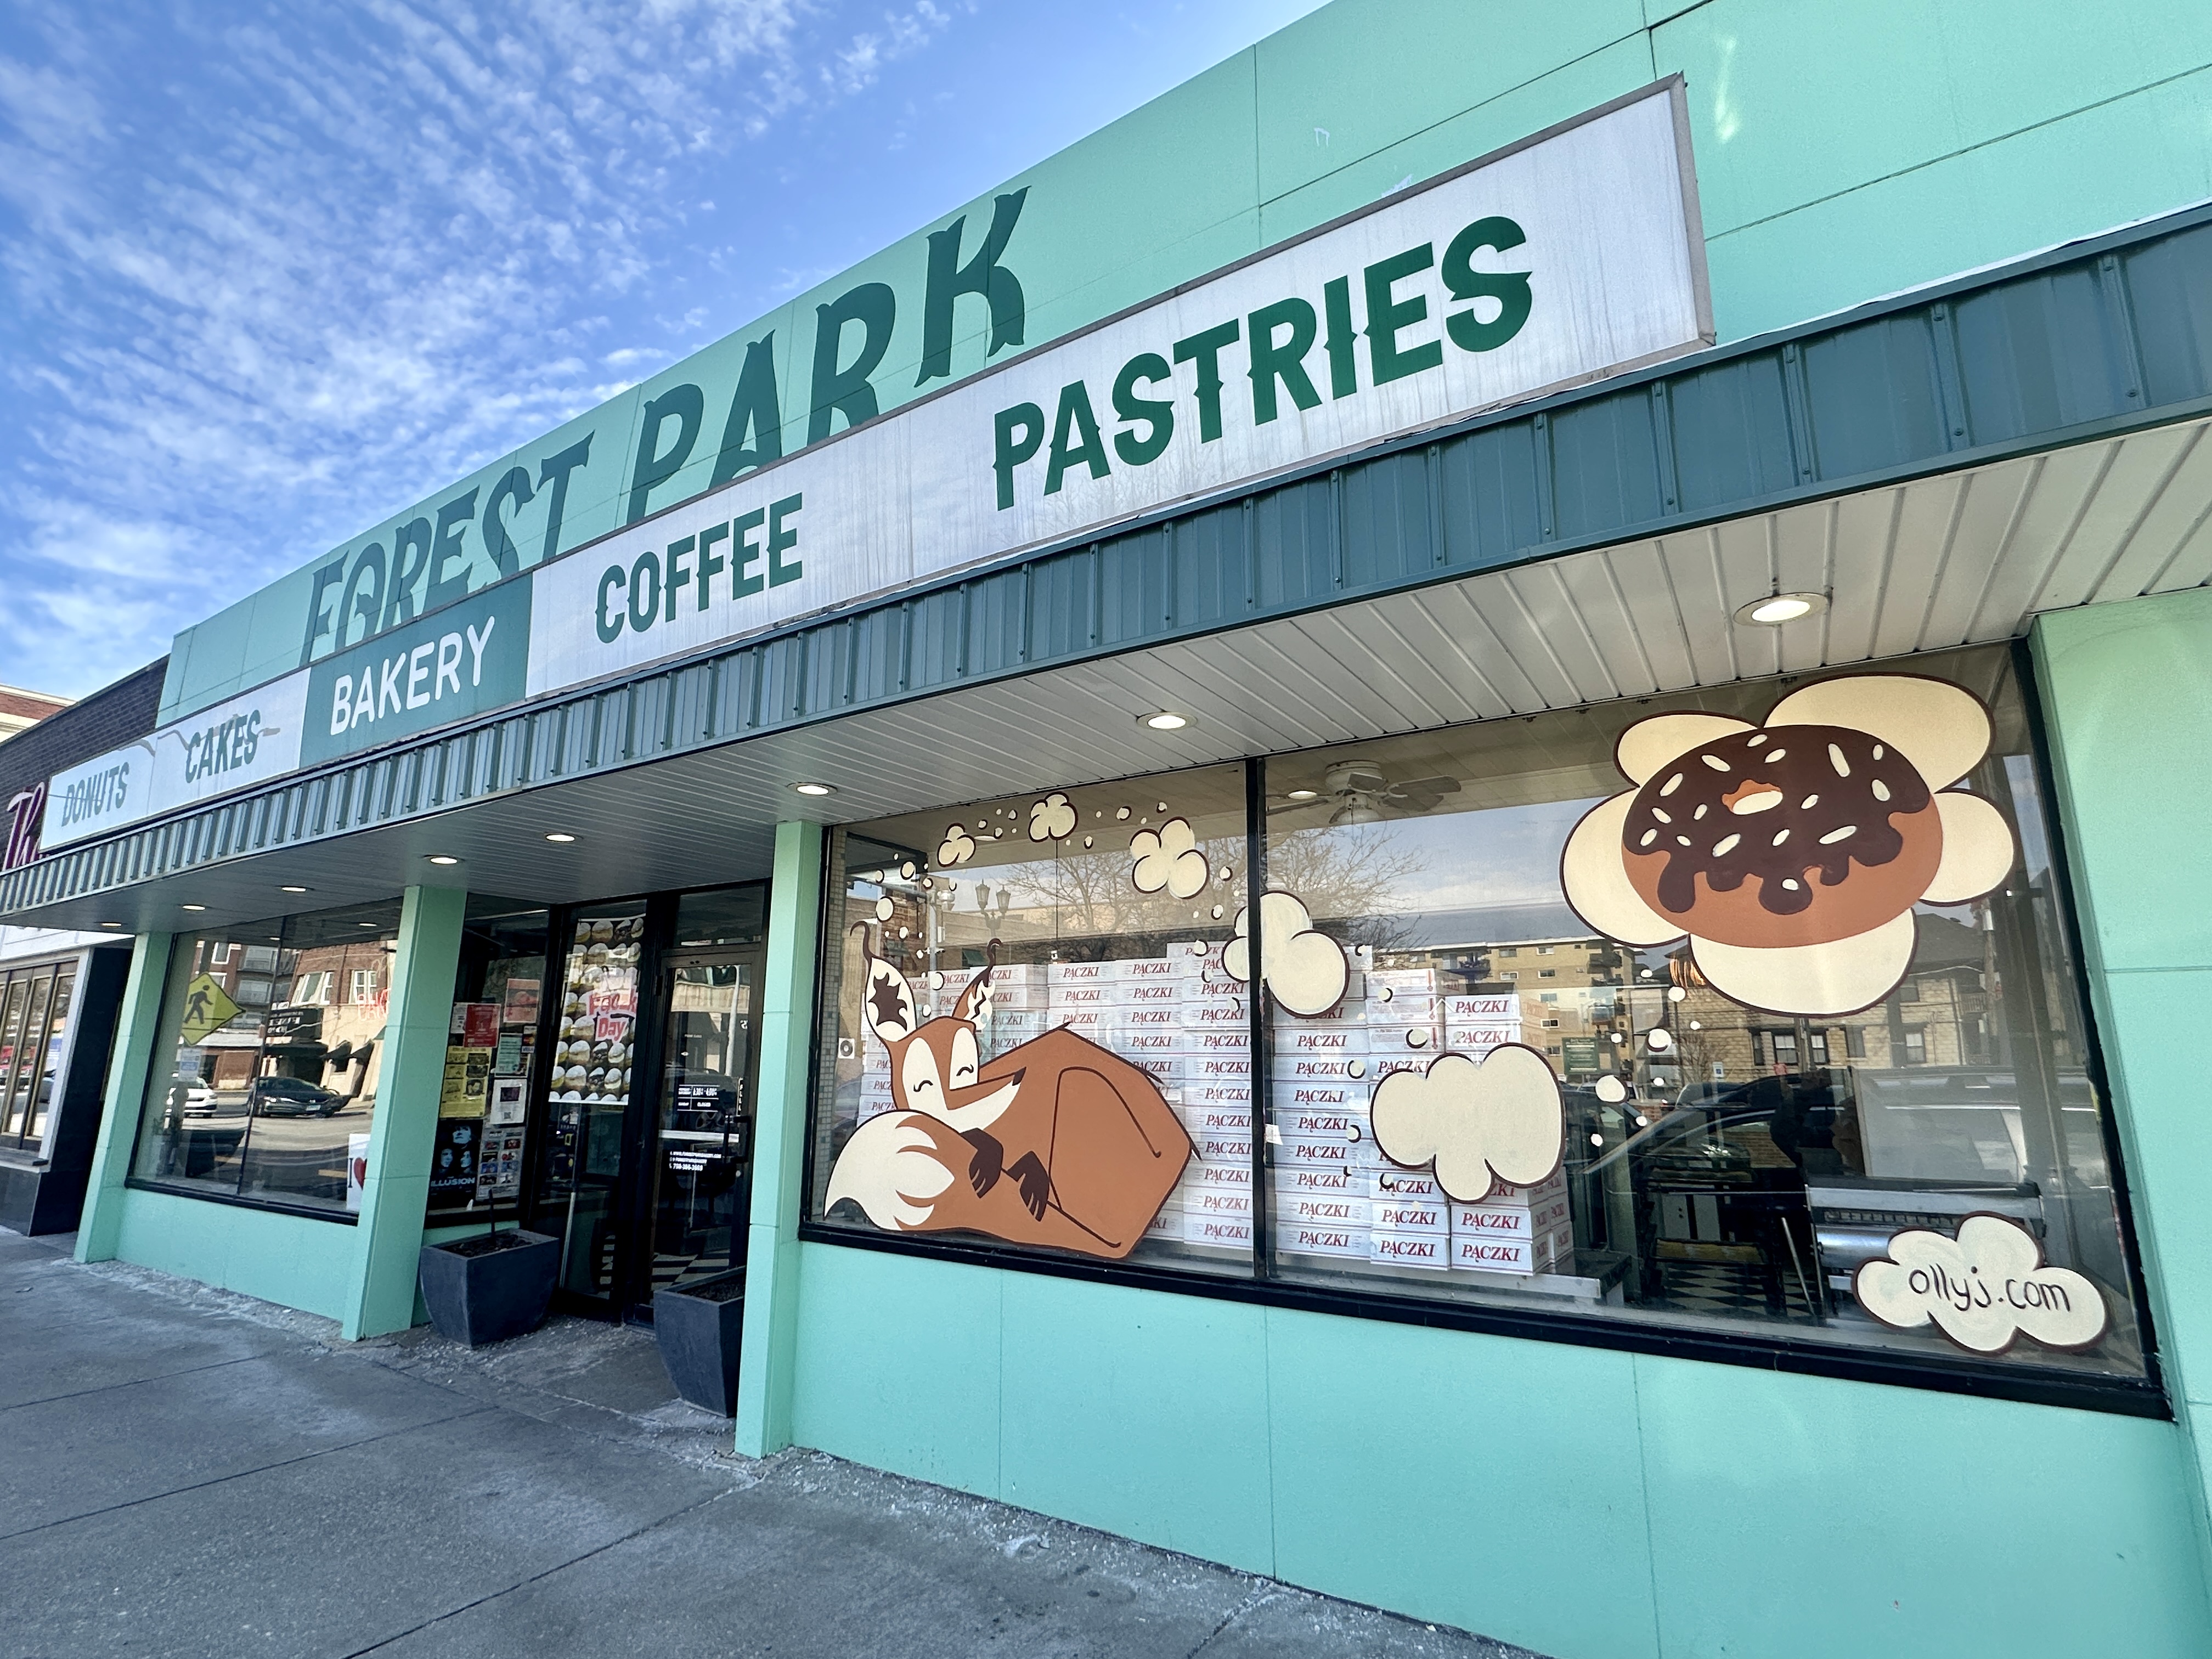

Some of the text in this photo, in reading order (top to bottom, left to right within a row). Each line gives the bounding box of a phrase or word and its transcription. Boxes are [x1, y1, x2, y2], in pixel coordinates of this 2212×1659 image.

[992, 216, 1533, 512] PASTRIES
[298, 185, 1032, 665] FOREST PARK
[595, 492, 803, 644] COFFEE
[330, 615, 495, 736] BAKERY
[185, 709, 261, 784] CAKES
[61, 761, 130, 827] DONUTS
[1063, 967, 1099, 980] PĄCZKI
[1132, 962, 1171, 977] PĄCZKI
[1065, 990, 1101, 1004] PĄCZKI
[1133, 987, 1173, 1001] PĄCZKI
[1201, 983, 1245, 998] PĄCZKI
[1455, 1000, 1509, 1017] PĄCZKI
[1131, 1011, 1171, 1026] PĄCZKI
[597, 1017, 627, 1041] Day
[1131, 1036, 1172, 1051] PĄCZKI
[1203, 1035, 1249, 1050] PĄCZKI
[1297, 1035, 1347, 1051] PĄCZKI
[1204, 1061, 1250, 1076] PĄCZKI
[1295, 1062, 1346, 1078] PĄCZKI
[1205, 1088, 1251, 1103] PĄCZKI
[1205, 1114, 1251, 1130] PĄCZKI
[1297, 1116, 1349, 1133] PĄCZKI
[1205, 1141, 1251, 1156] PĄCZKI
[1295, 1145, 1347, 1161] PĄCZKI
[430, 1177, 476, 1187] ILLUSION
[1204, 1169, 1250, 1184] PĄCZKI
[1204, 1195, 1250, 1212] PĄCZKI
[1299, 1201, 1350, 1219] PĄCZKI
[1382, 1209, 1437, 1227] PĄCZKI
[1462, 1212, 1520, 1231] PĄCZKI
[1204, 1223, 1250, 1240] PĄCZKI
[1297, 1231, 1350, 1248] PĄCZKI
[1379, 1240, 1436, 1258] PĄCZKI
[1462, 1244, 1520, 1262] PĄCZKI
[1908, 1263, 2071, 1312] ollyj.com
